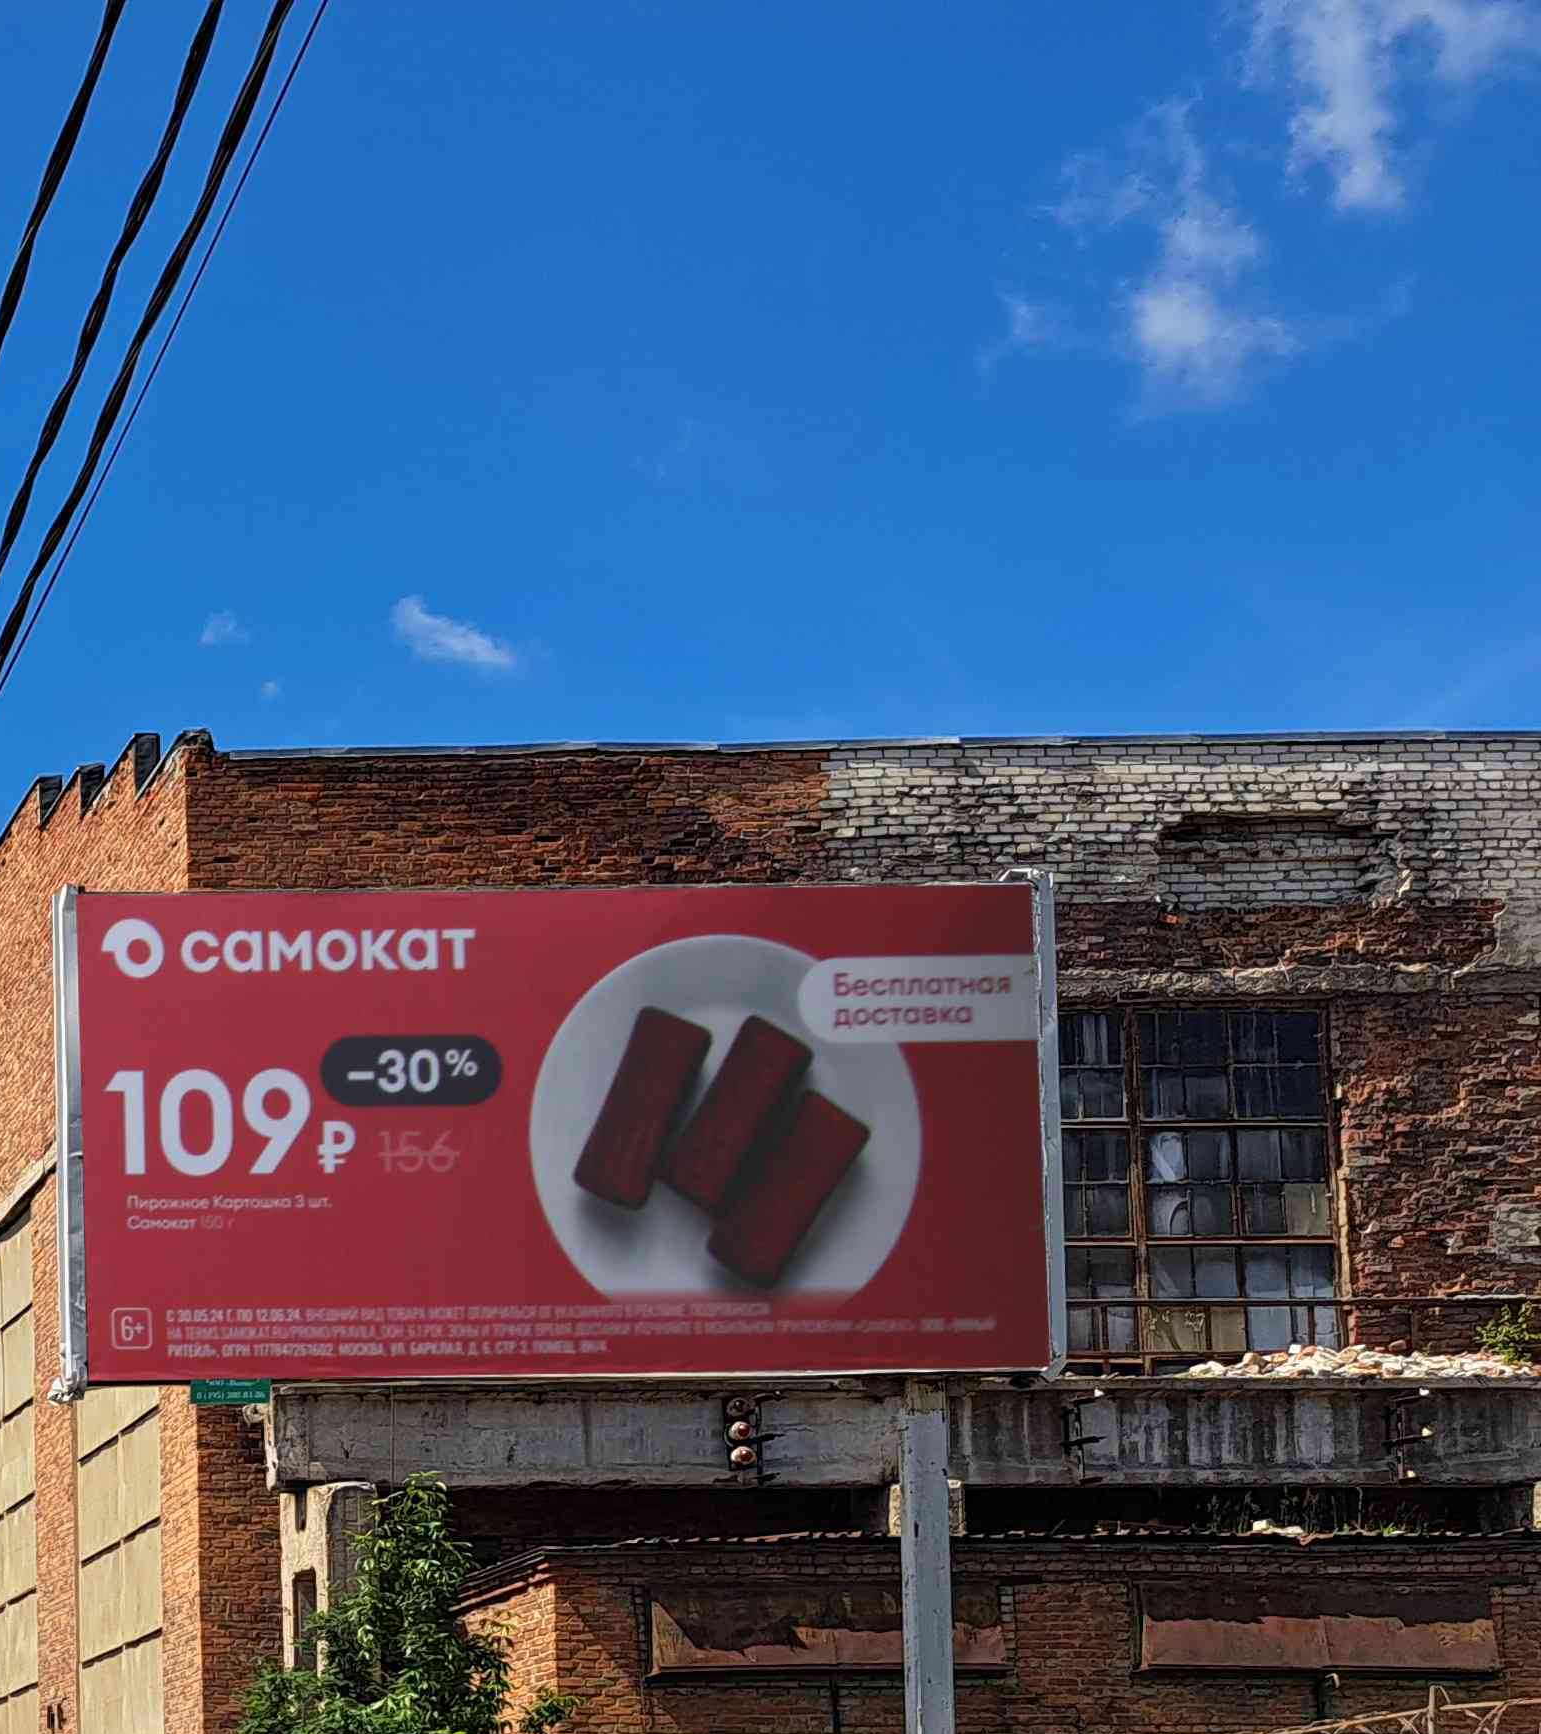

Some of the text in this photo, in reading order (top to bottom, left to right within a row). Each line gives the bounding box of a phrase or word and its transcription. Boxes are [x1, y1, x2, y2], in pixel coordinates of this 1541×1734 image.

[180, 928, 477, 974] самокат
[833, 972, 1012, 998] Бесплатная
[832, 1006, 974, 1029] доставка
[378, 1129, 461, 1174] 156
[126, 1194, 333, 1212] Пирожное Картошка 3 шт.
[126, 1215, 197, 1230] Самокат
[120, 1315, 145, 1342] 6+
